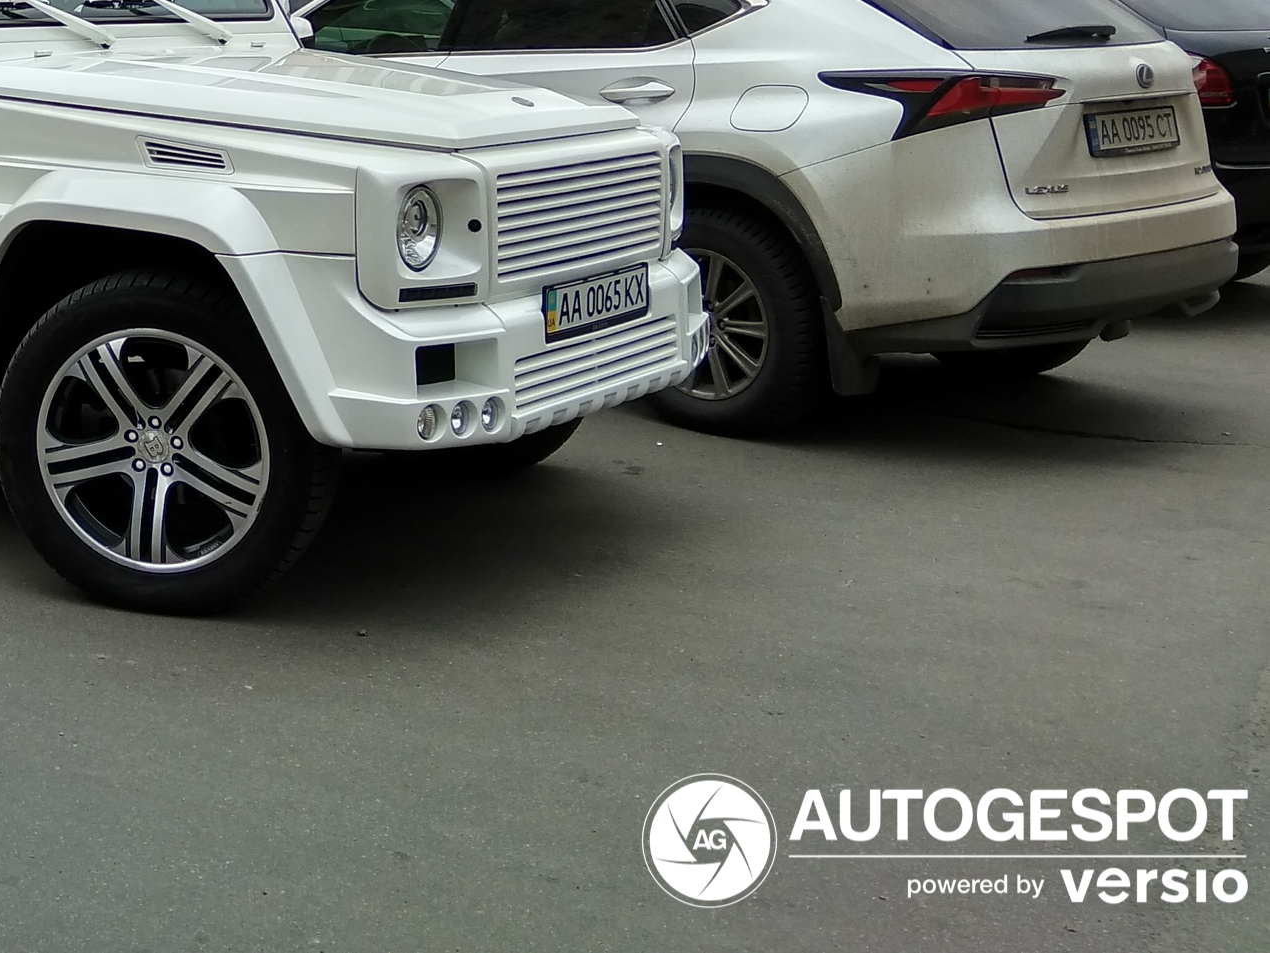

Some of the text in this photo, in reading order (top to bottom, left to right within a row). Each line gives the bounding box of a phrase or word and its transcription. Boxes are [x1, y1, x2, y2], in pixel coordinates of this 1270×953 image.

[1101, 113, 1173, 145] AA 0095 CT
[1025, 184, 1070, 195] LEXUS
[559, 273, 644, 326] AA 0065 KX
